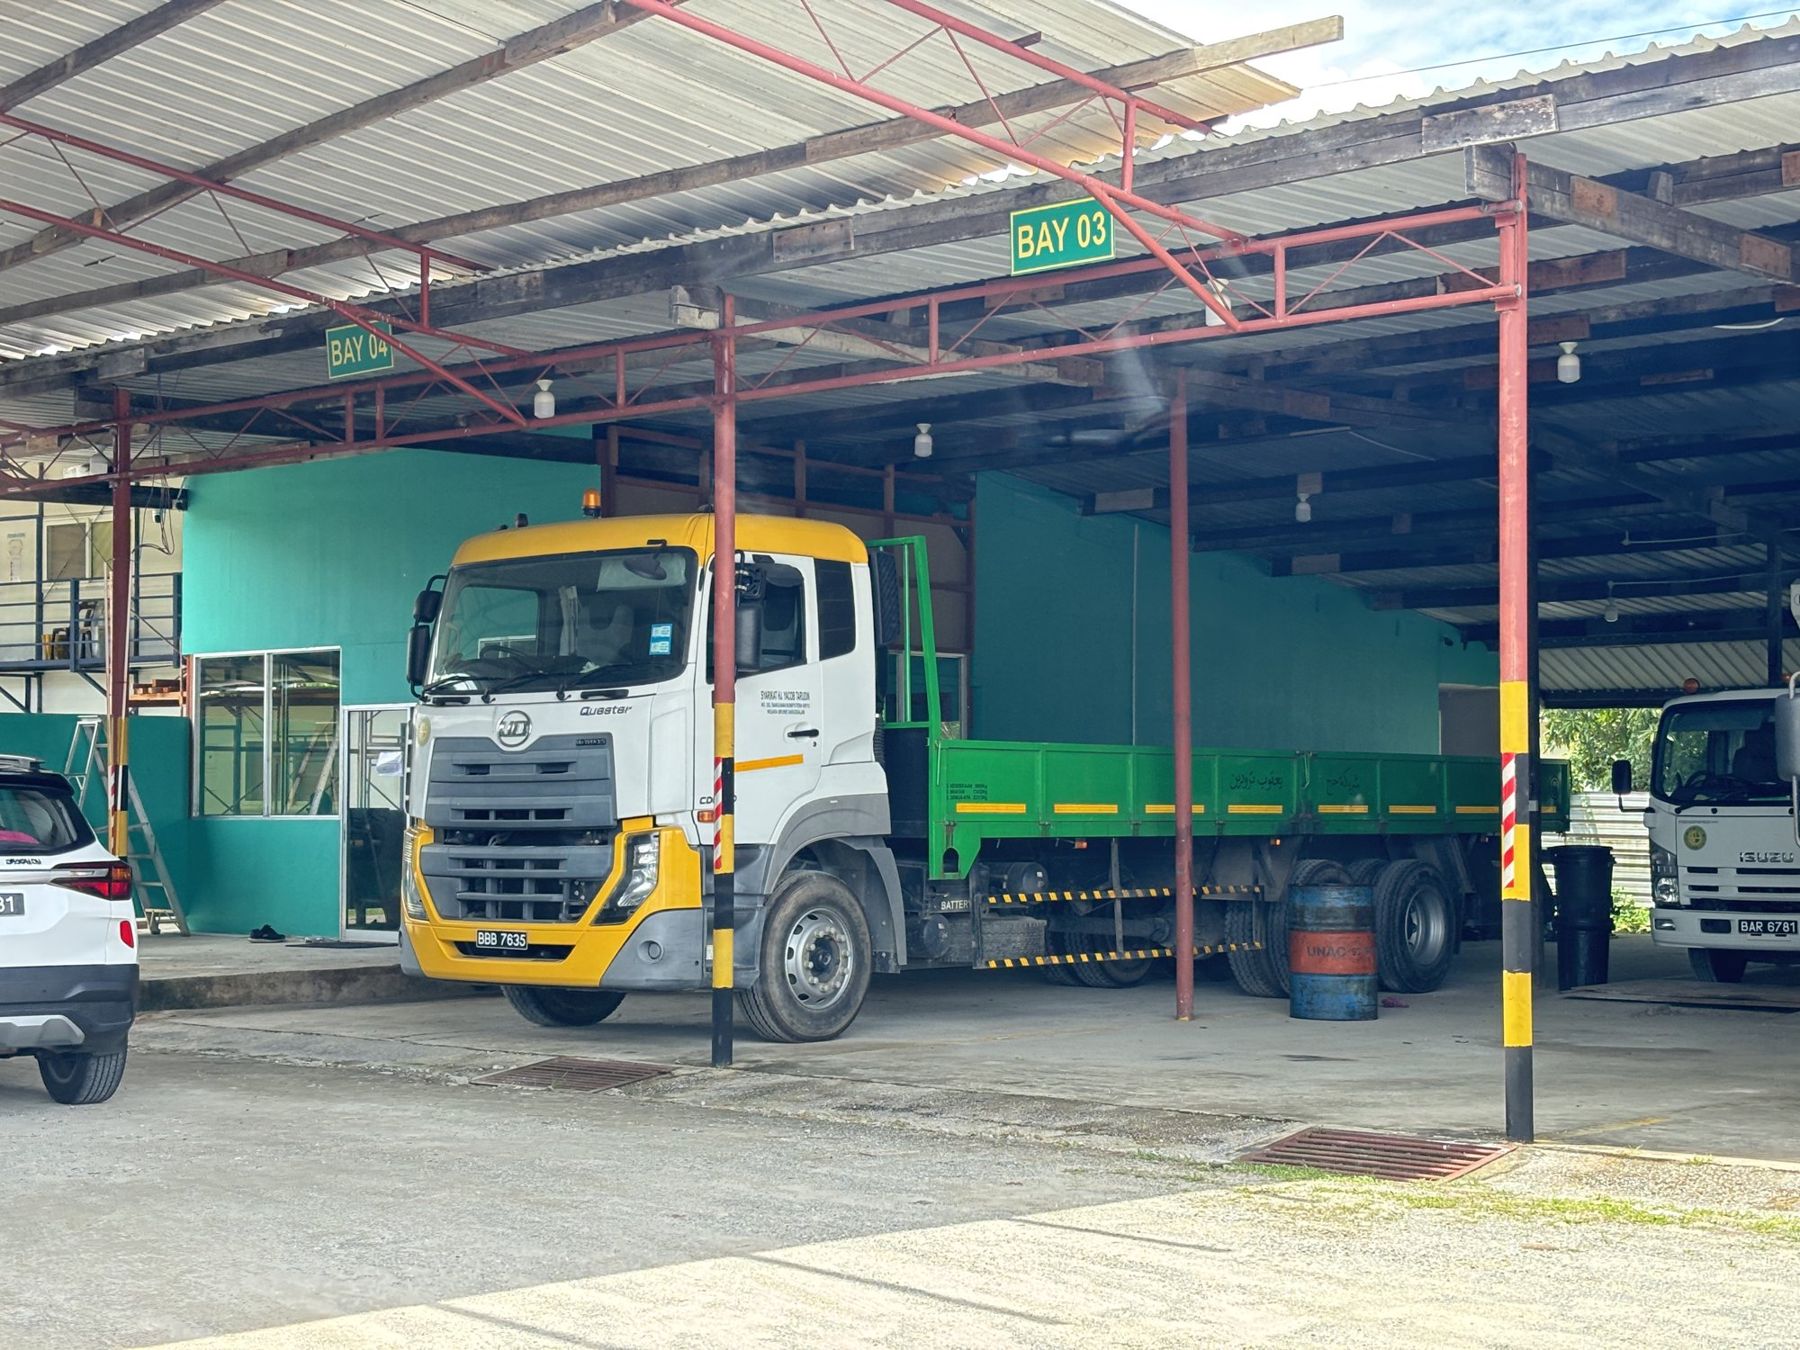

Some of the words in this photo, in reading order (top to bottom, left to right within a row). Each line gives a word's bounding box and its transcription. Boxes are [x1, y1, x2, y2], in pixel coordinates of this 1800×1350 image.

[1018, 217, 1069, 258] BAY
[1077, 211, 1106, 248] 03
[331, 335, 364, 366] BAY
[368, 334, 388, 359] 04
[580, 706, 632, 716] Quester
[1739, 852, 1794, 863] ISUZU
[1741, 921, 1763, 932] BAR
[1767, 922, 1796, 932] 6781
[478, 932, 497, 945] BBB
[500, 933, 526, 947] 7635
